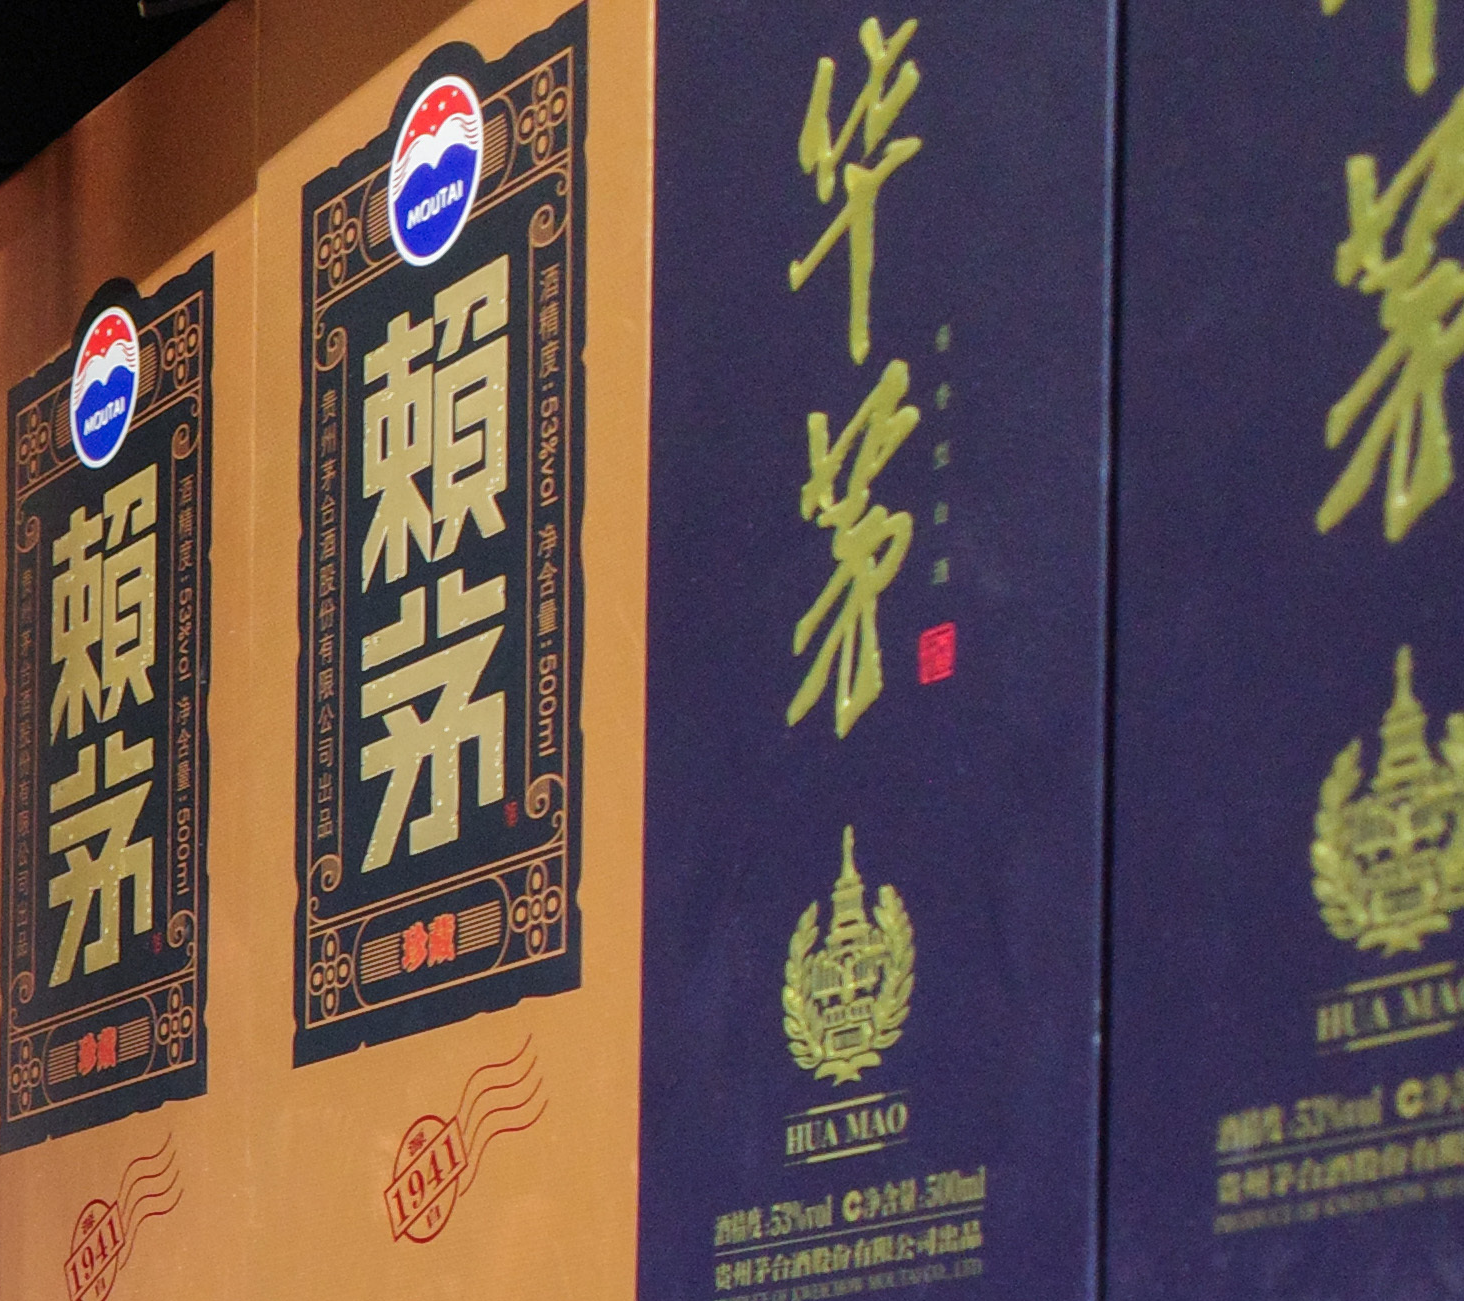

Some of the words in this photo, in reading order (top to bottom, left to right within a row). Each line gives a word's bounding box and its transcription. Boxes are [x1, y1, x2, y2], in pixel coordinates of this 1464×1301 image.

[407, 180, 463, 230] MOUTAI
[82, 398, 126, 437] MOUTAI
[402, 912, 456, 972] 珍藏
[786, 1119, 838, 1156] HUA
[846, 1103, 907, 1143] MAO
[392, 1133, 460, 1228] 1941
[70, 1217, 121, 1295] 1941
